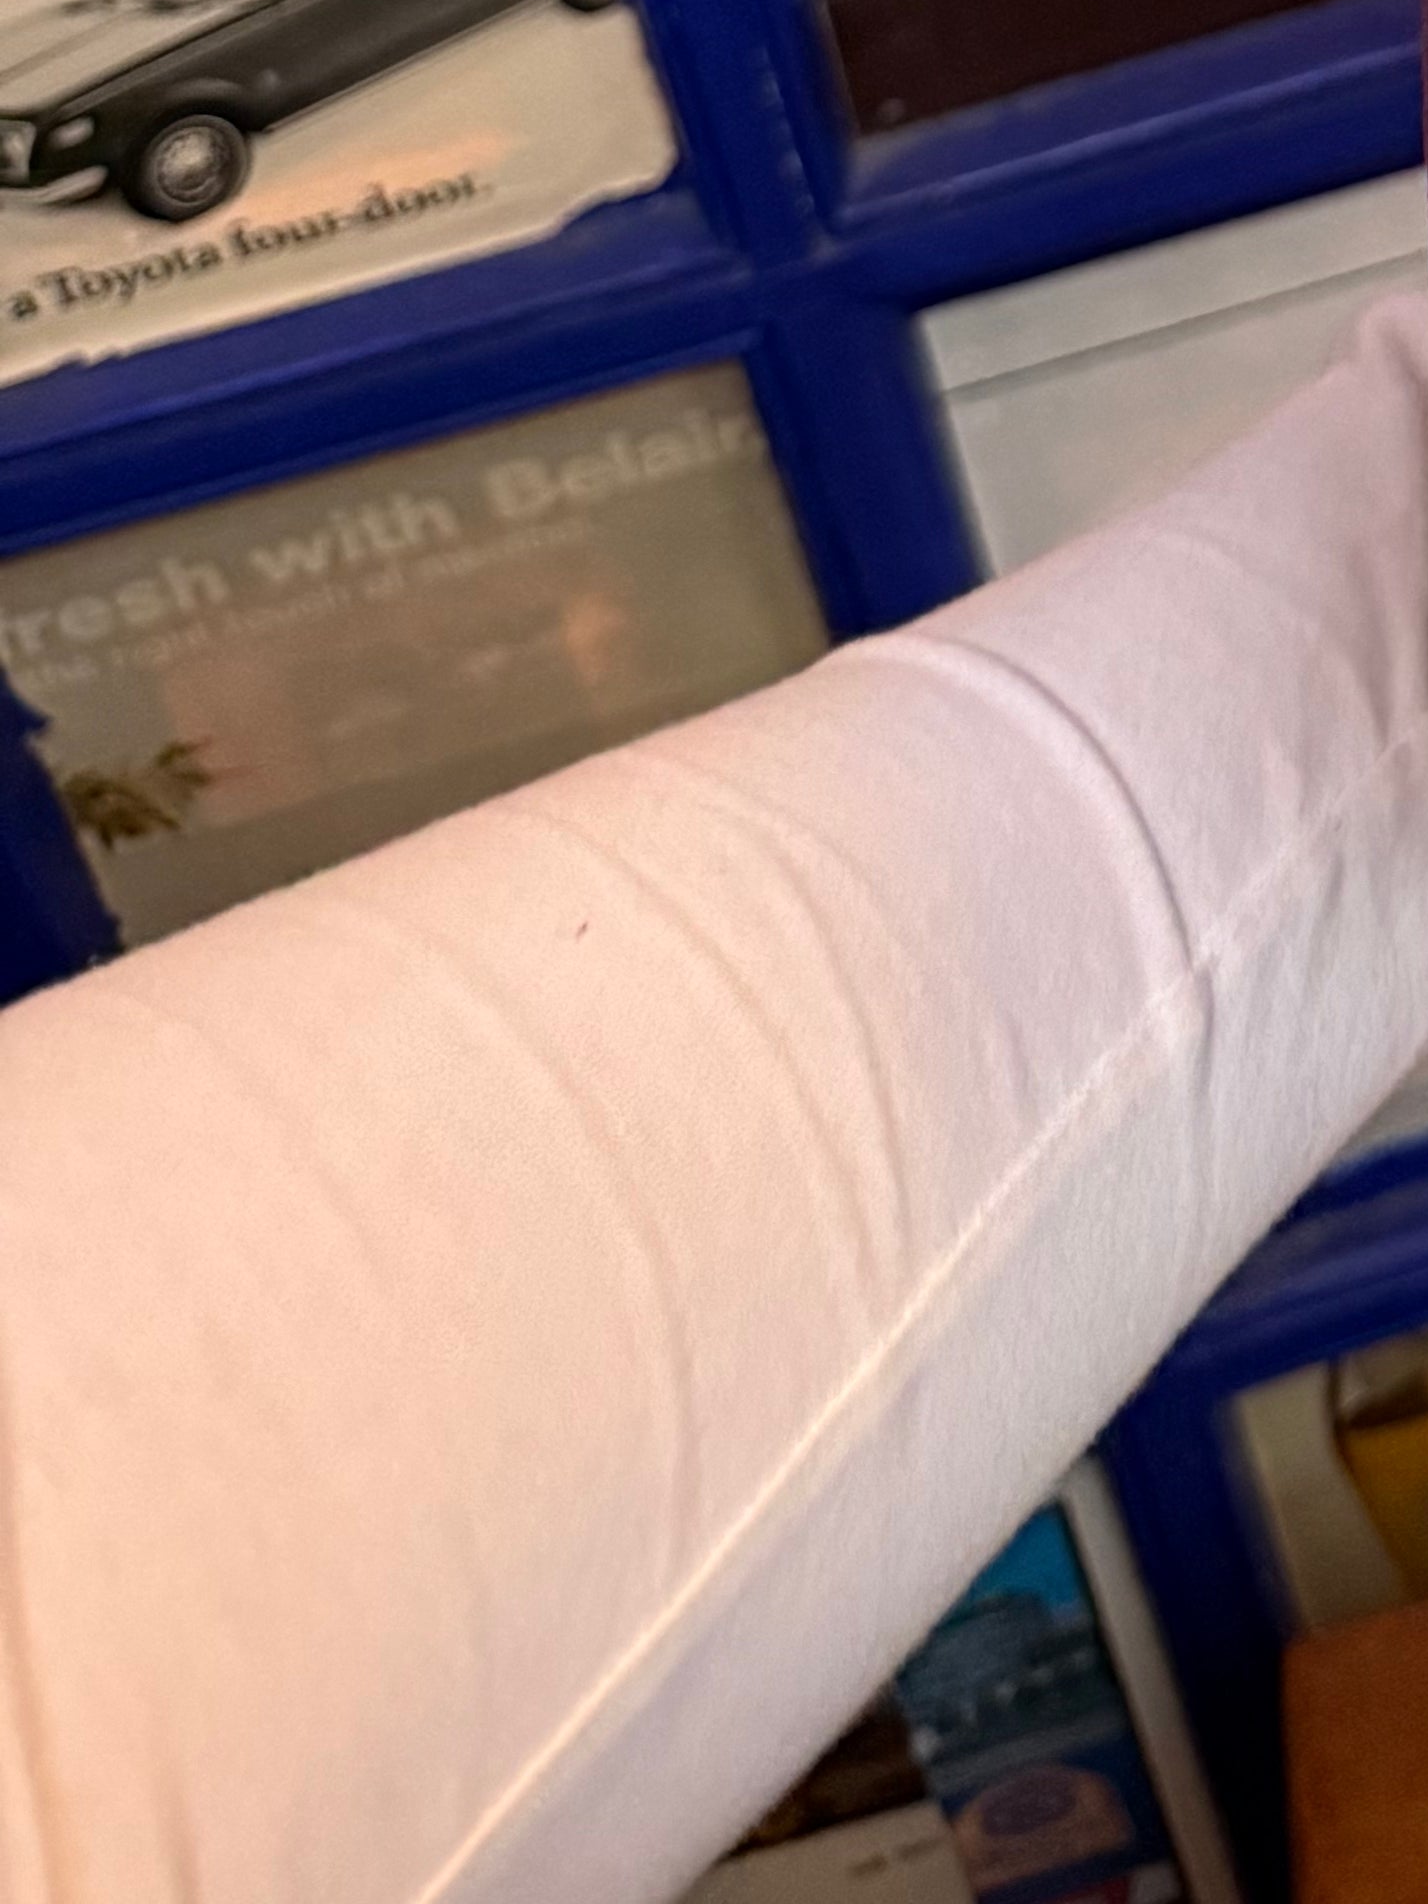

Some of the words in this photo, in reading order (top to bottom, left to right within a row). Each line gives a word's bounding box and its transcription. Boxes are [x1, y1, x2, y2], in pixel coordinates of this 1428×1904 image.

[11, 289, 40, 320] a
[39, 238, 224, 306] Toyota
[250, 494, 460, 581] with
